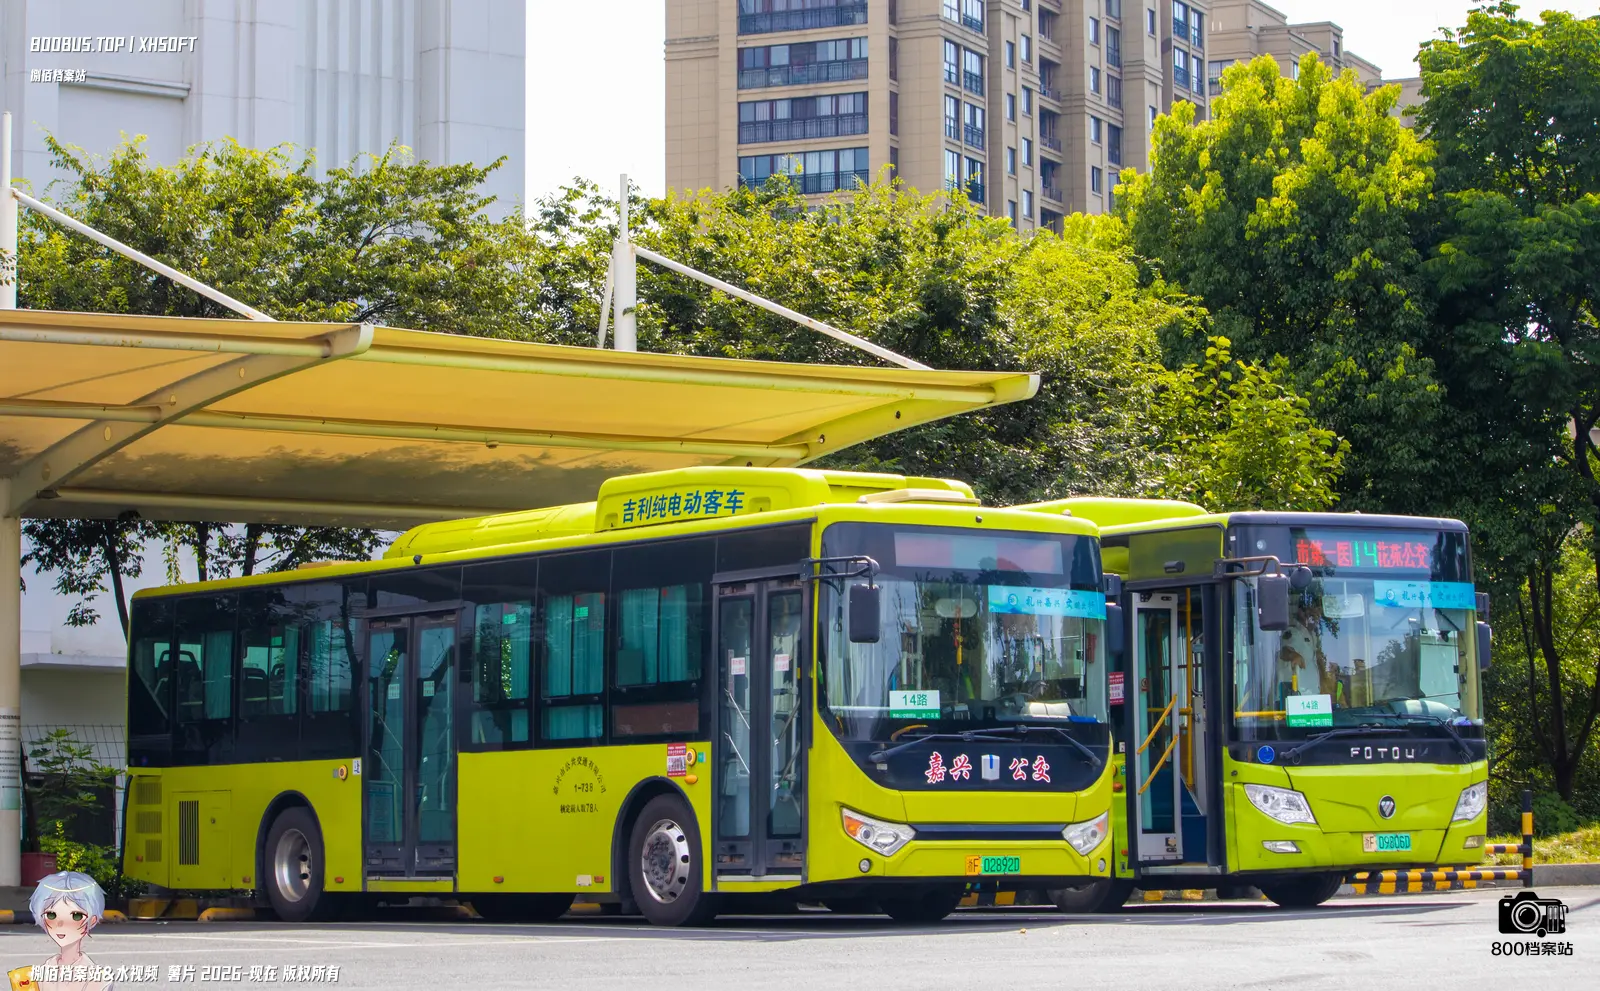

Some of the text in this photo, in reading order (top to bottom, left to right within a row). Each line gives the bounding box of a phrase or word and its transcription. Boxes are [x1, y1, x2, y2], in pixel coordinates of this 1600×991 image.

[622, 489, 745, 524] 吉利纯电动客车
[902, 693, 928, 707] 14路
[925, 751, 1051, 784] 嘉兴 公交
